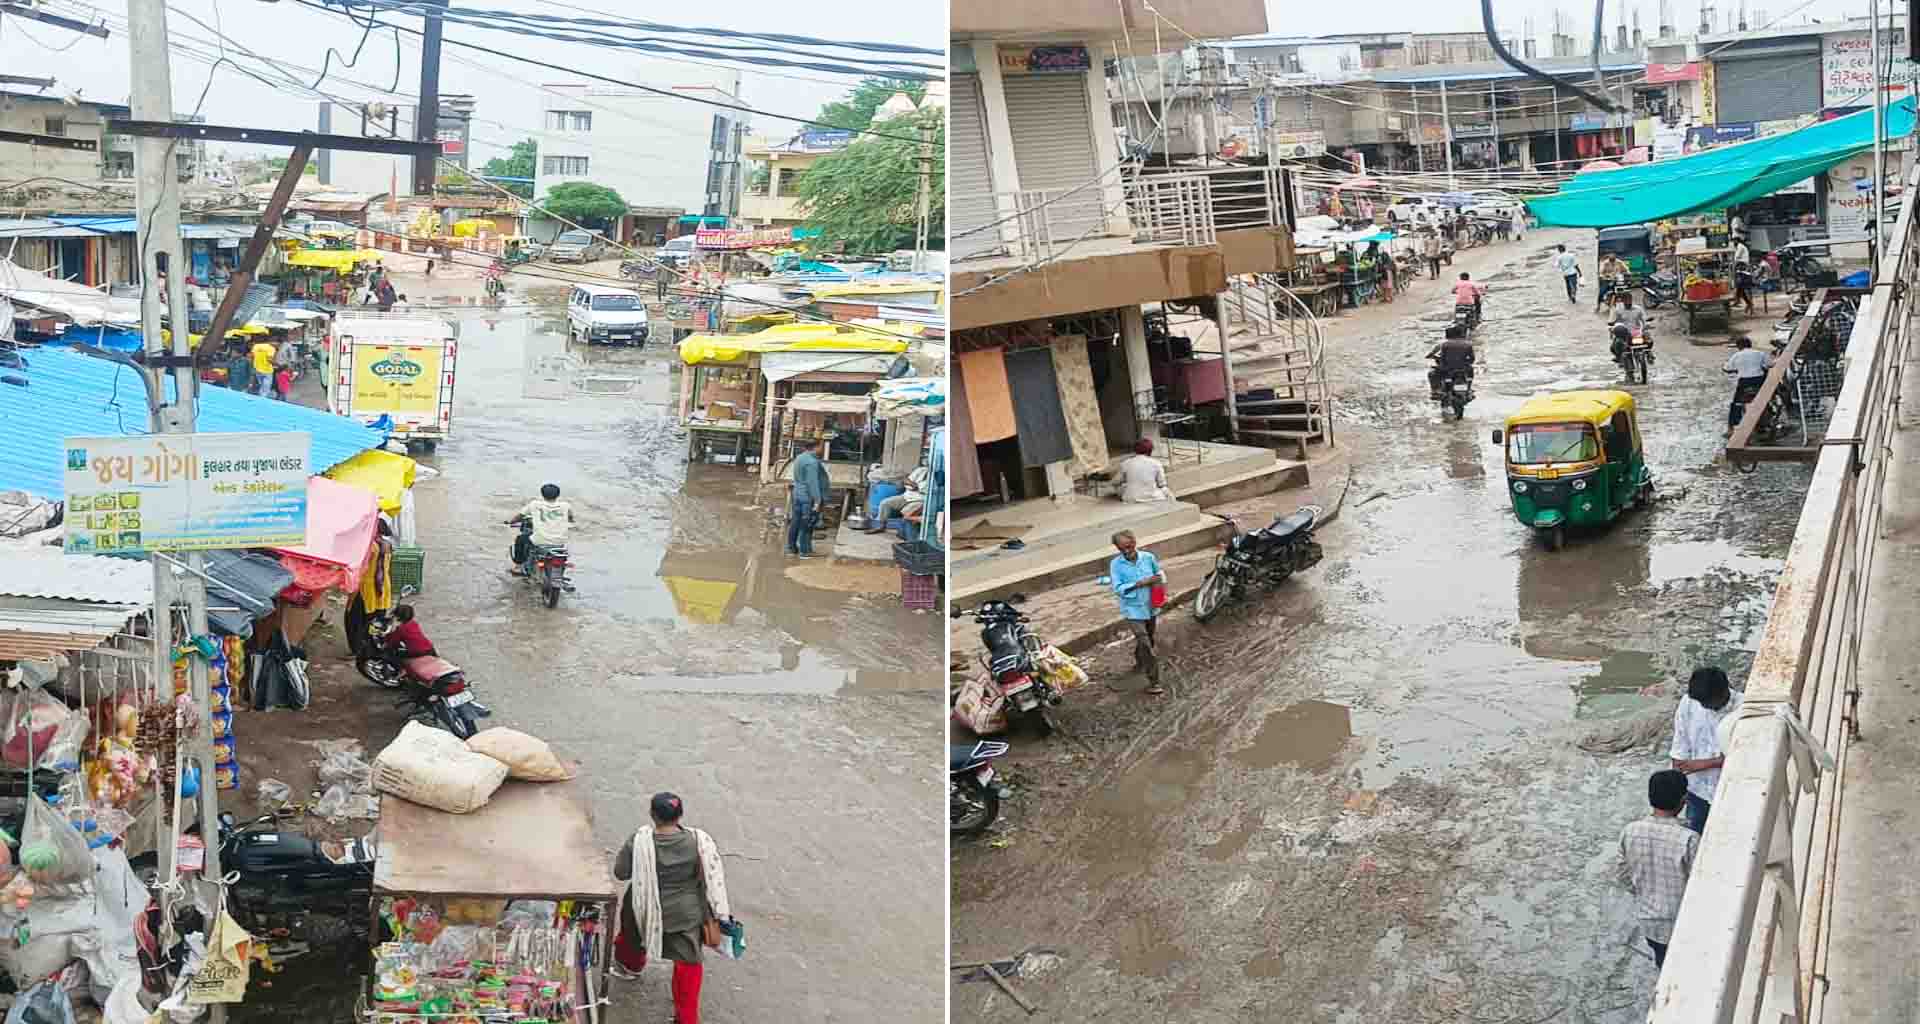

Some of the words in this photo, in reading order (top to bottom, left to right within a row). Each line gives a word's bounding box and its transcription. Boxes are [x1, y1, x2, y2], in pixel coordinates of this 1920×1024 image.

[375, 364, 418, 375] GOPAL
[91, 455, 133, 483] જય
[141, 441, 197, 482] ગોગા
